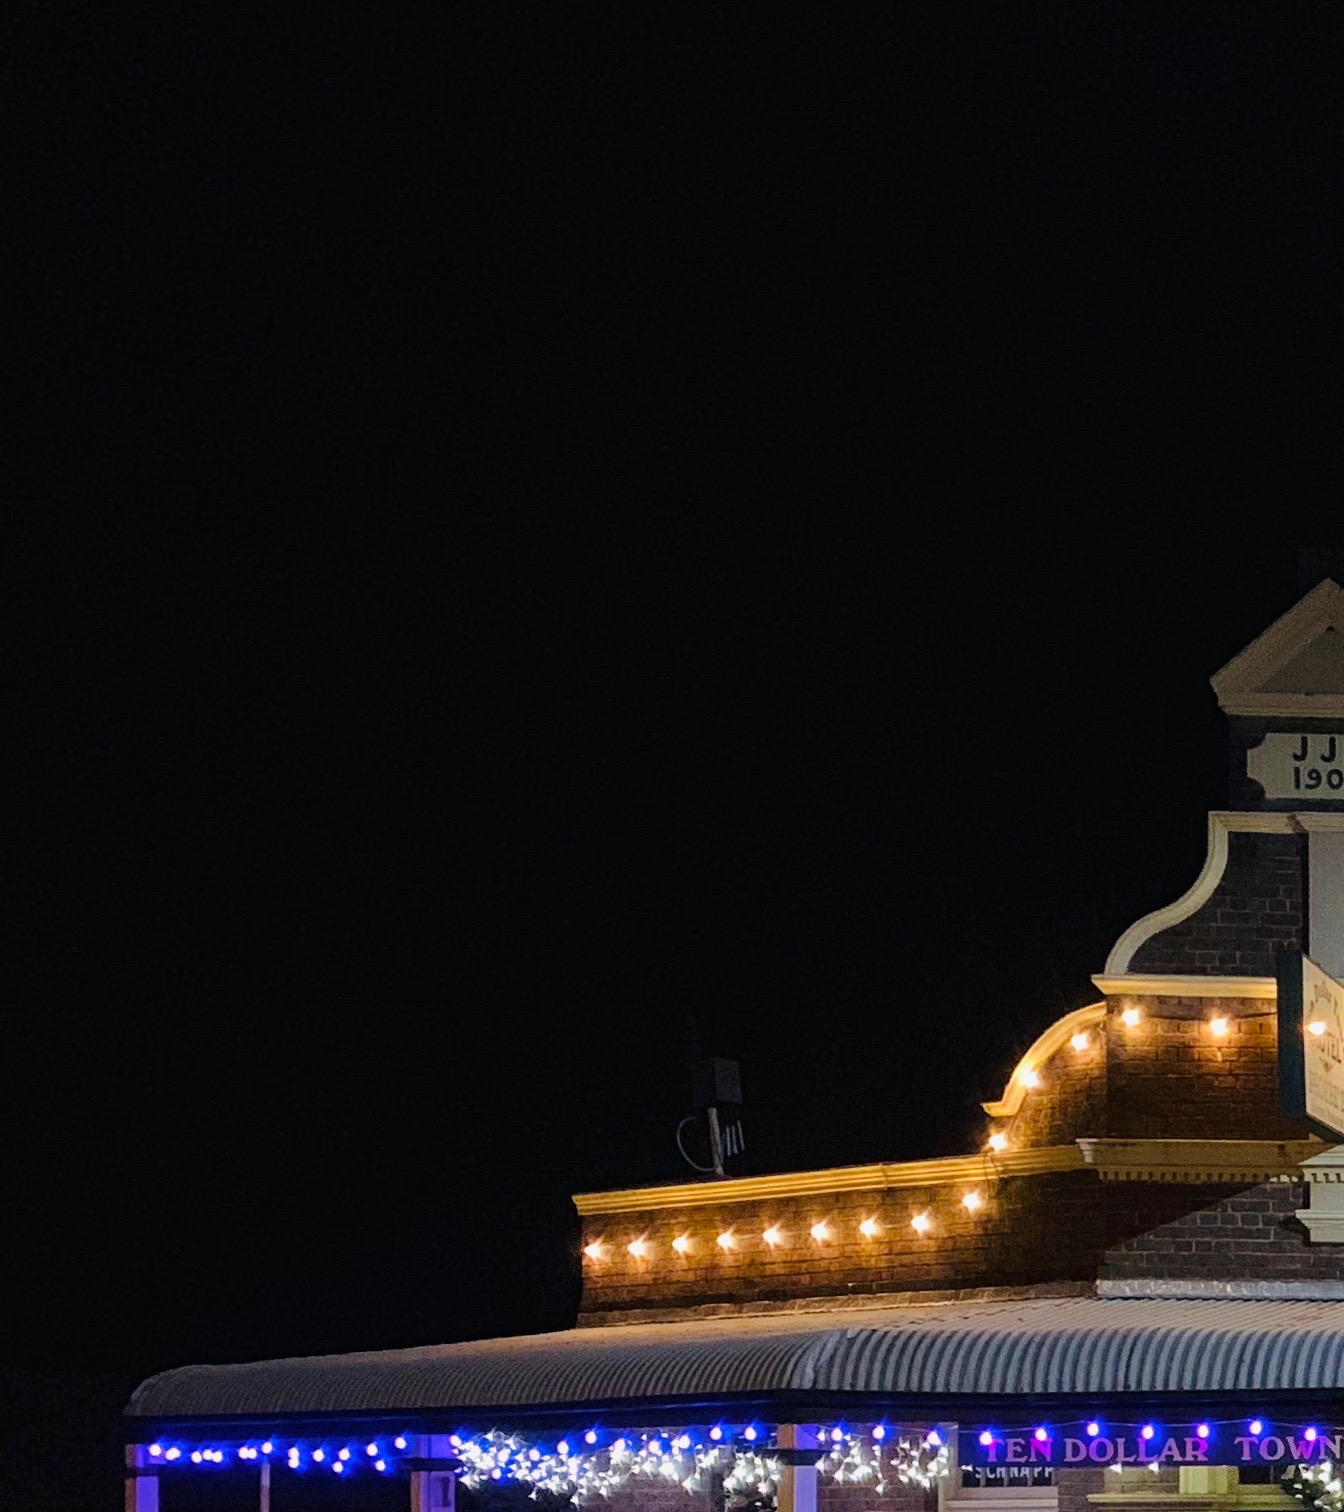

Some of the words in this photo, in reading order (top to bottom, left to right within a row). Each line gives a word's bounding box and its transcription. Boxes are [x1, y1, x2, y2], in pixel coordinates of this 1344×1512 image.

[981, 1437, 1054, 1463] TEN
[1063, 1437, 1208, 1463] DOLLAR
[1234, 1434, 1344, 1462] TOWN
